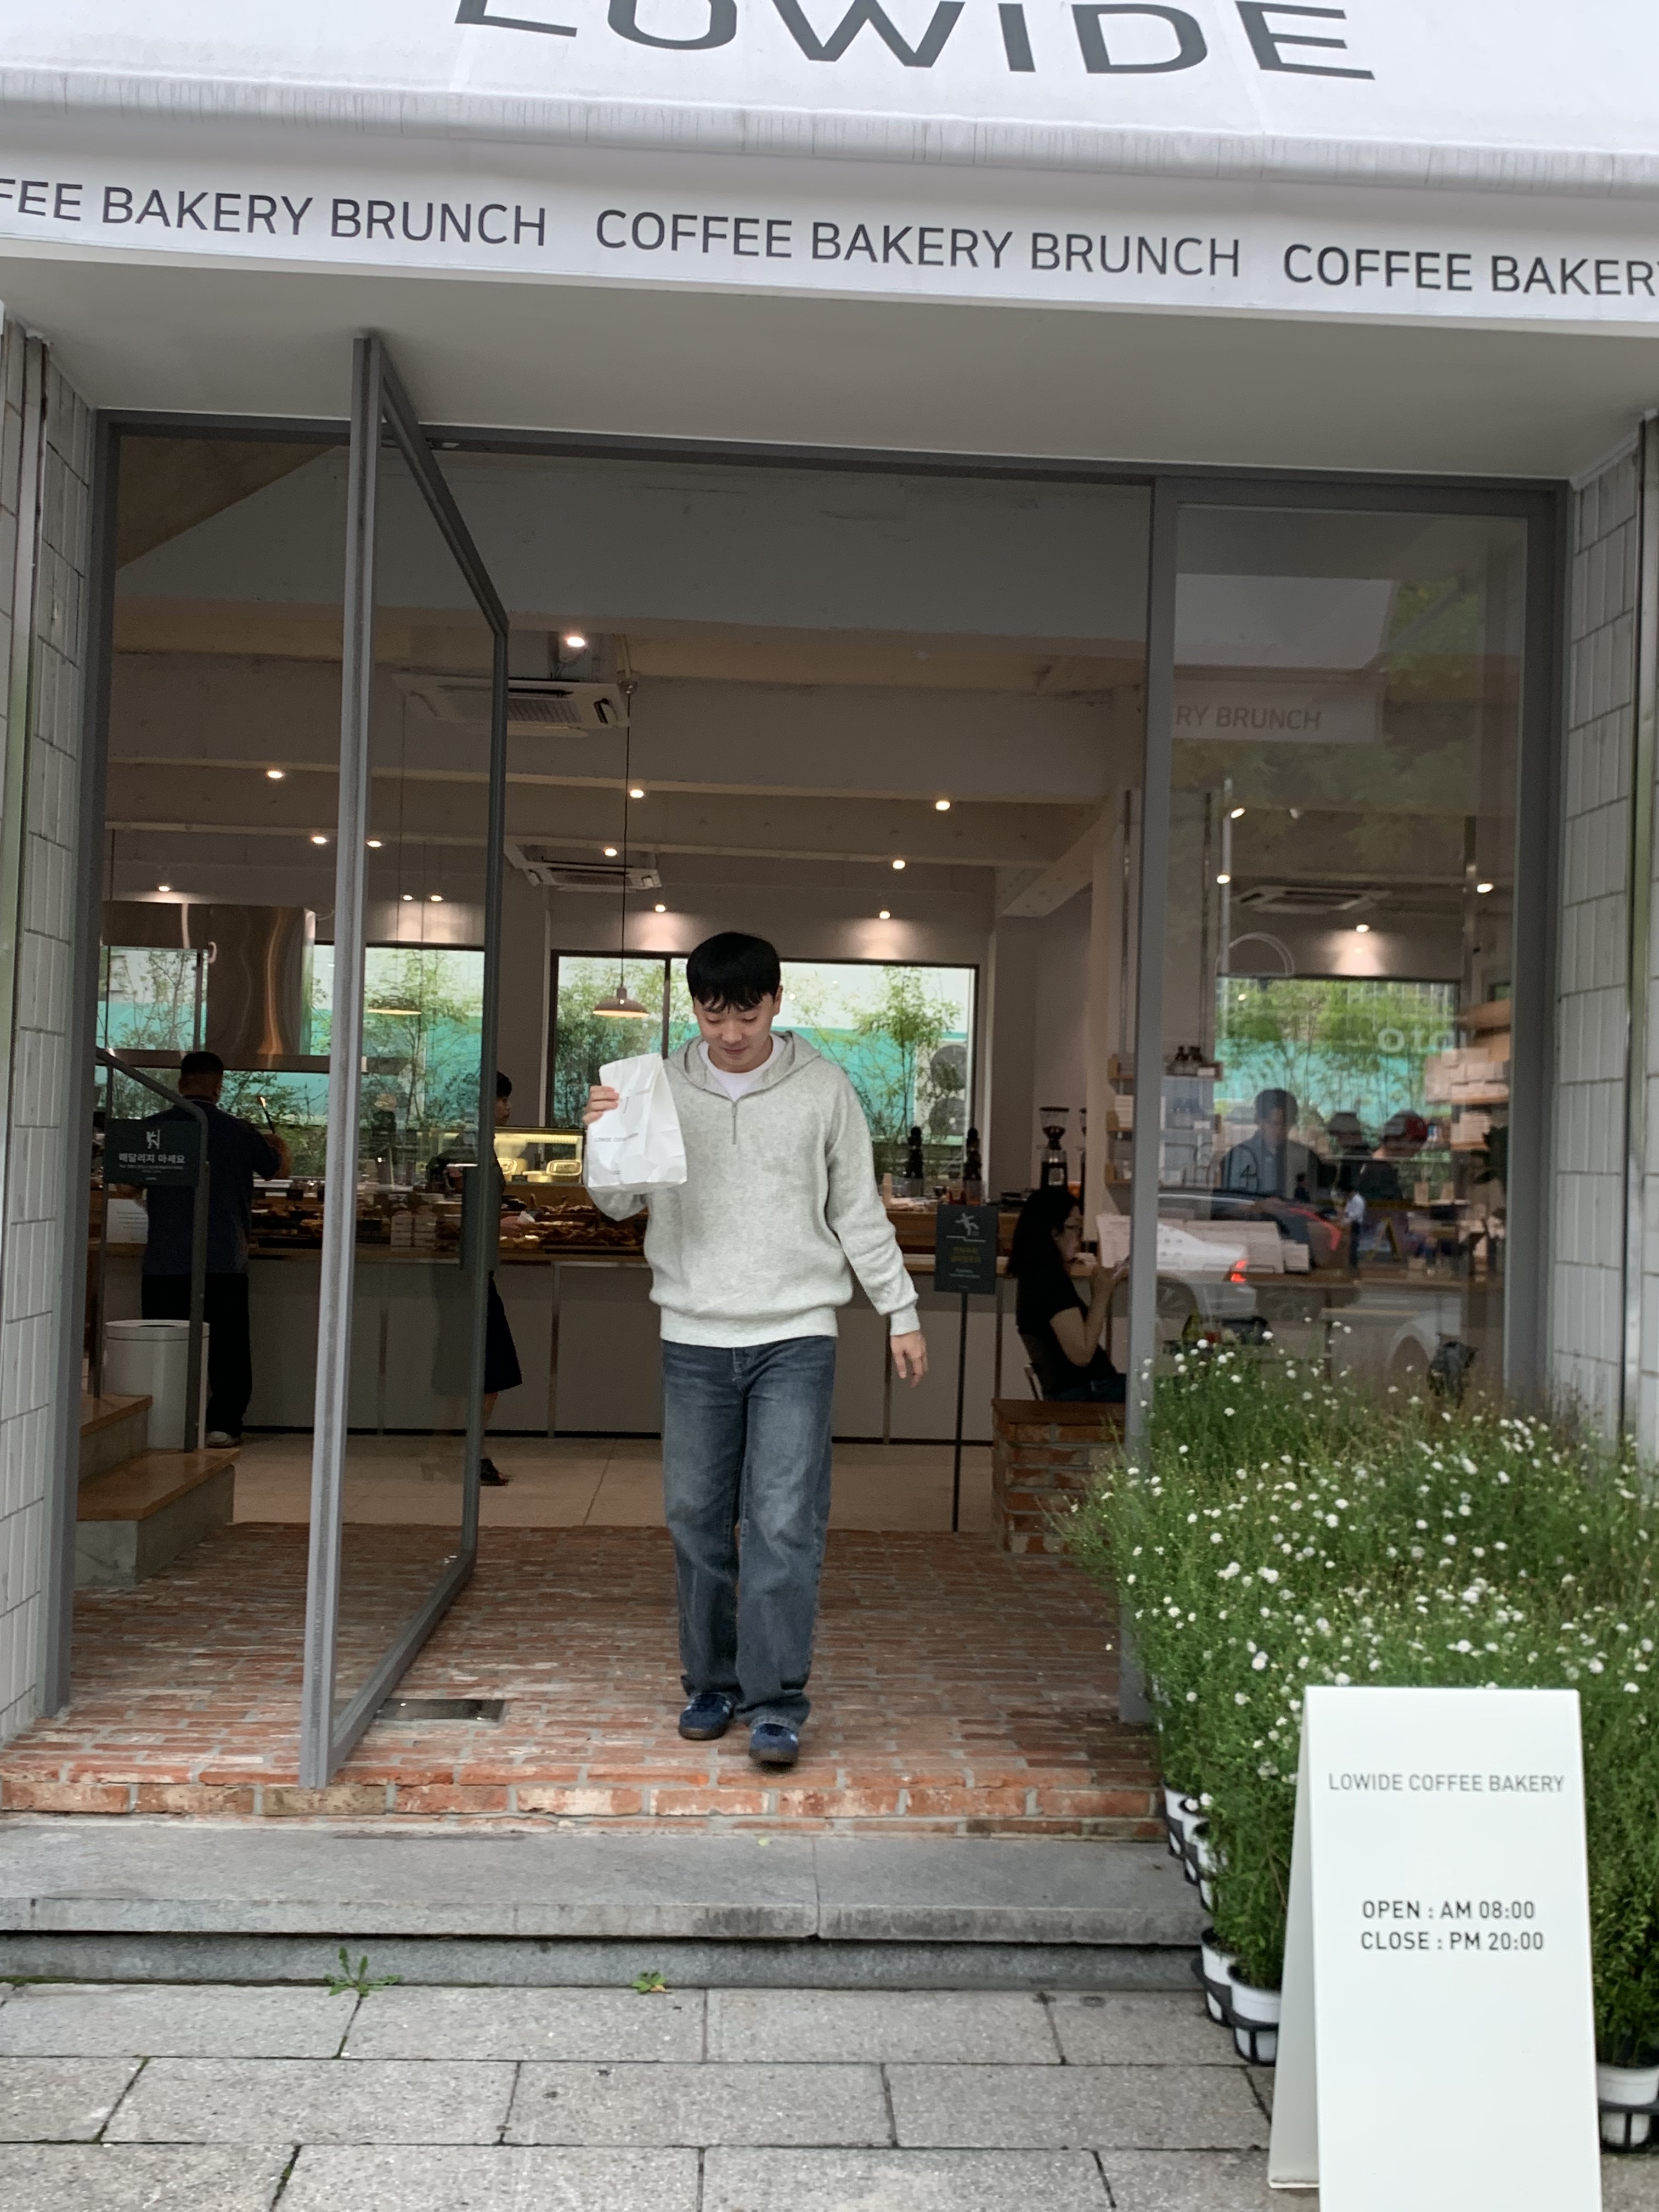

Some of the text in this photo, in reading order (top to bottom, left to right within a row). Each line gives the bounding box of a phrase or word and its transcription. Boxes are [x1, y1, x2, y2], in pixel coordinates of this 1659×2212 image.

[102, 186, 313, 235] BAKERY
[331, 198, 545, 246] BRUNCH
[596, 209, 1239, 278] COFFEE BAKERY BRUNCH
[1284, 244, 1659, 297] COFFEE BAKER
[1216, 706, 1322, 731] BRUNCH
[1329, 1773, 1564, 1792] LOWIDE COFFEE BAKERY
[1362, 1900, 1420, 1919] OPEN
[1440, 1900, 1472, 1919] AM
[1479, 1900, 1535, 1920] 08:00
[1361, 1931, 1430, 1950] CLOSE
[1449, 1931, 1481, 1950] PM
[1488, 1931, 1544, 1951] 20:00
